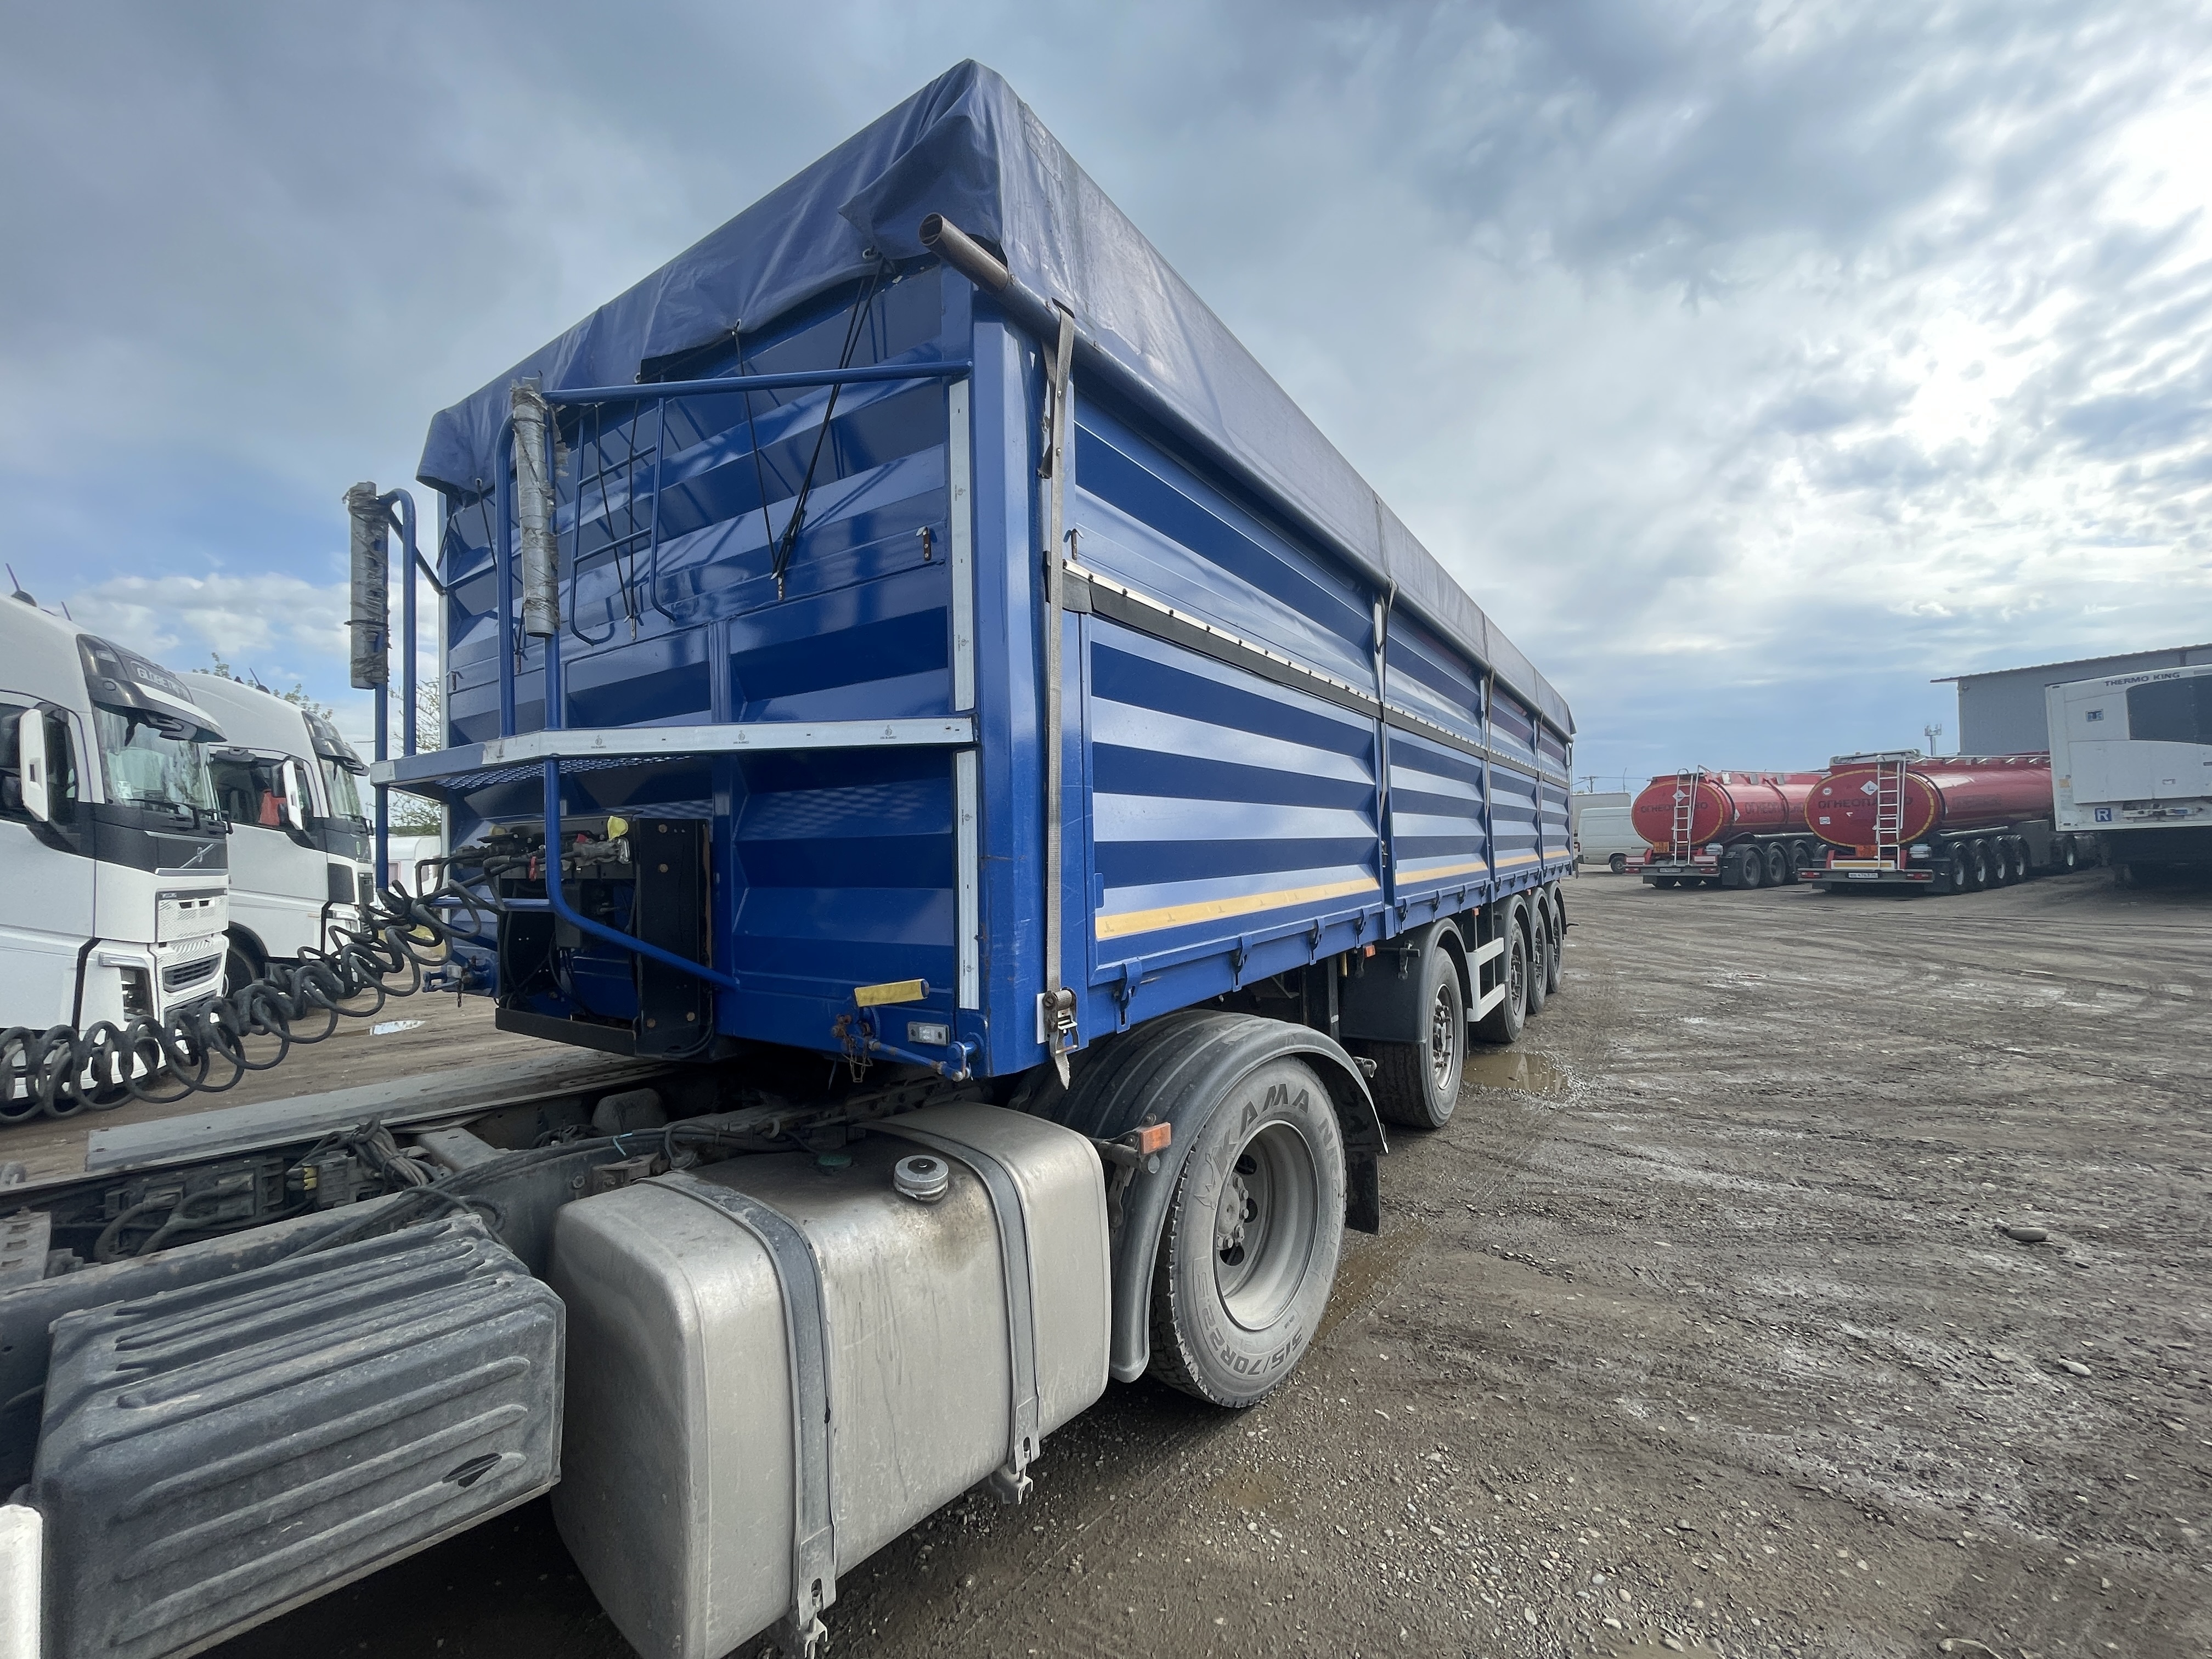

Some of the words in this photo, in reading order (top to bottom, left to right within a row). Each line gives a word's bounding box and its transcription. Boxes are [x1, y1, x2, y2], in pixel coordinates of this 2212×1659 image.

[2104, 675, 2149, 686] THERMO
[2153, 672, 2181, 680] KING
[1641, 802, 1708, 812] ОГНЕОО
[2097, 808, 2109, 821] R
[1215, 1084, 1309, 1176] KAMA
[1197, 1271, 1303, 1375] 315/70R22.5
